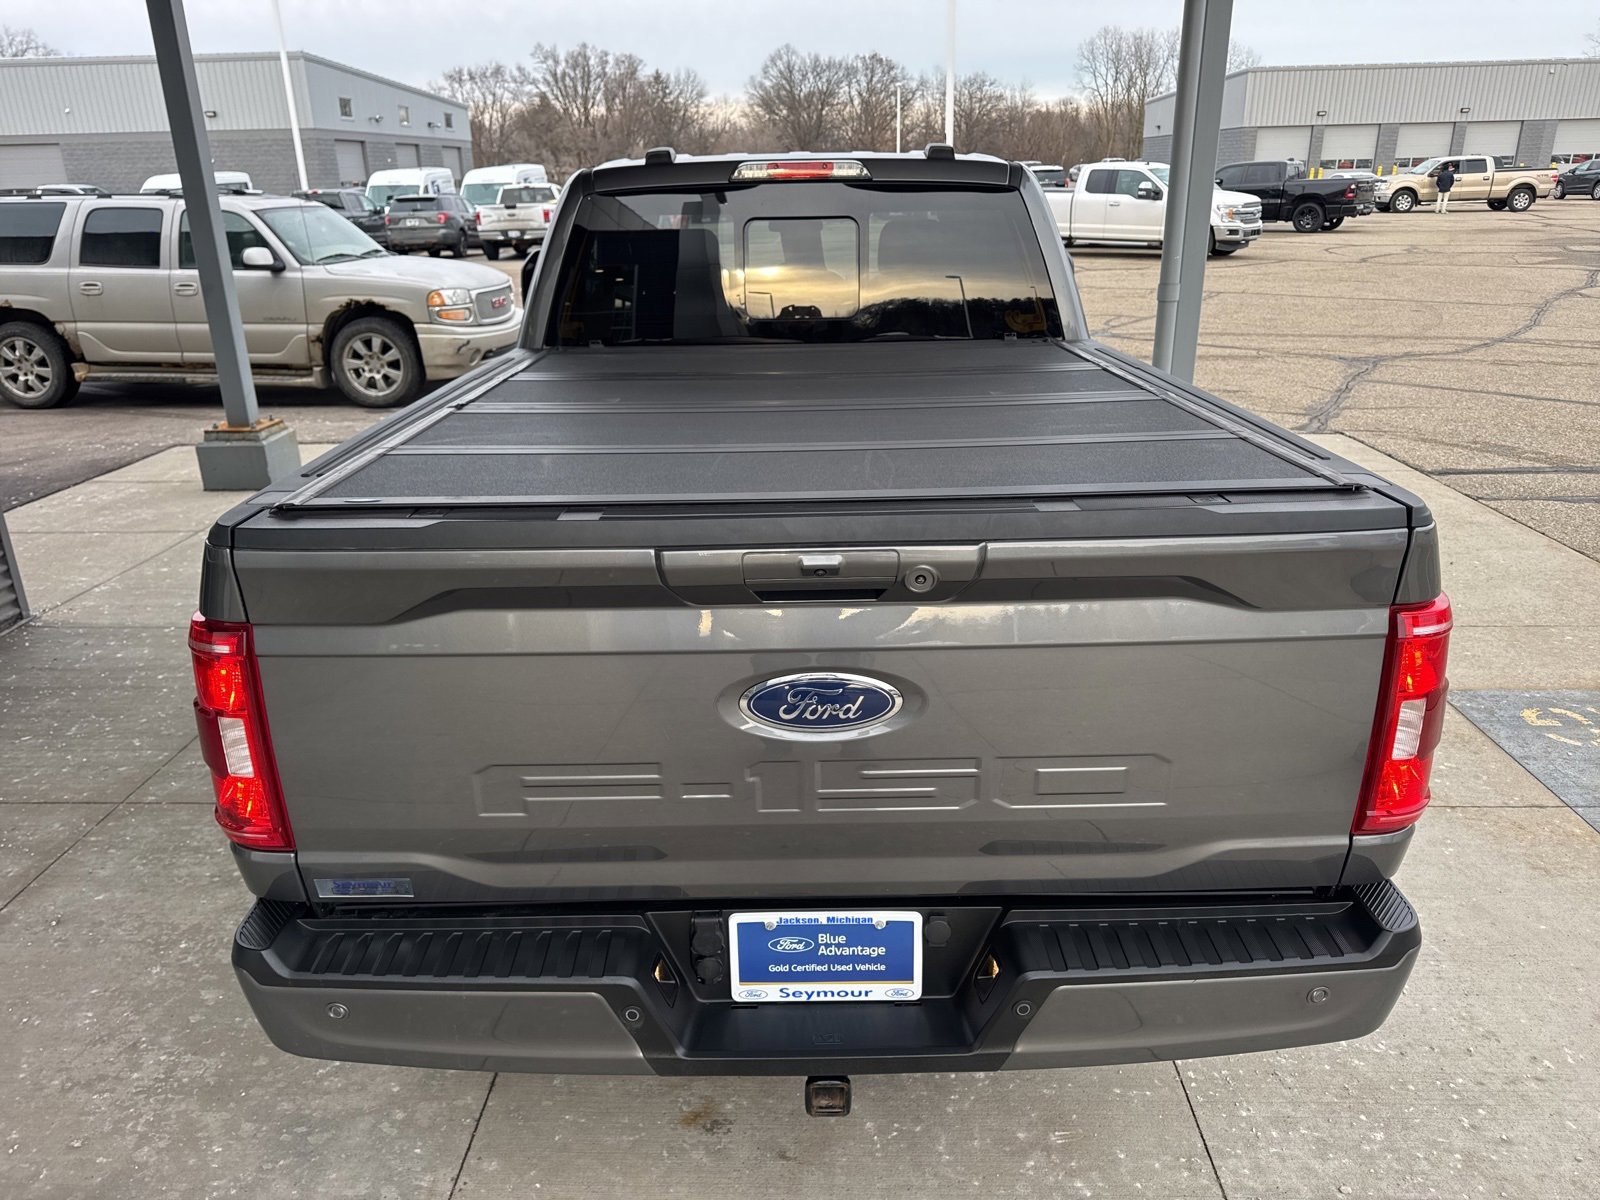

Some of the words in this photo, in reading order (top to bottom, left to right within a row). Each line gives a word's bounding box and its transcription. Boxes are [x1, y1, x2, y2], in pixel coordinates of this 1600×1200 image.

[778, 686, 865, 721] Ford
[472, 752, 1172, 817] F-150
[826, 916, 873, 924] Michigan
[776, 938, 806, 951] Ford
[818, 933, 846, 944] Blue
[818, 945, 886, 957] Advantage
[768, 964, 789, 972] Gold
[791, 963, 827, 972] Certified
[830, 963, 853, 971] Used
[855, 963, 886, 971] Vehicle
[779, 987, 873, 1000] Seymour
